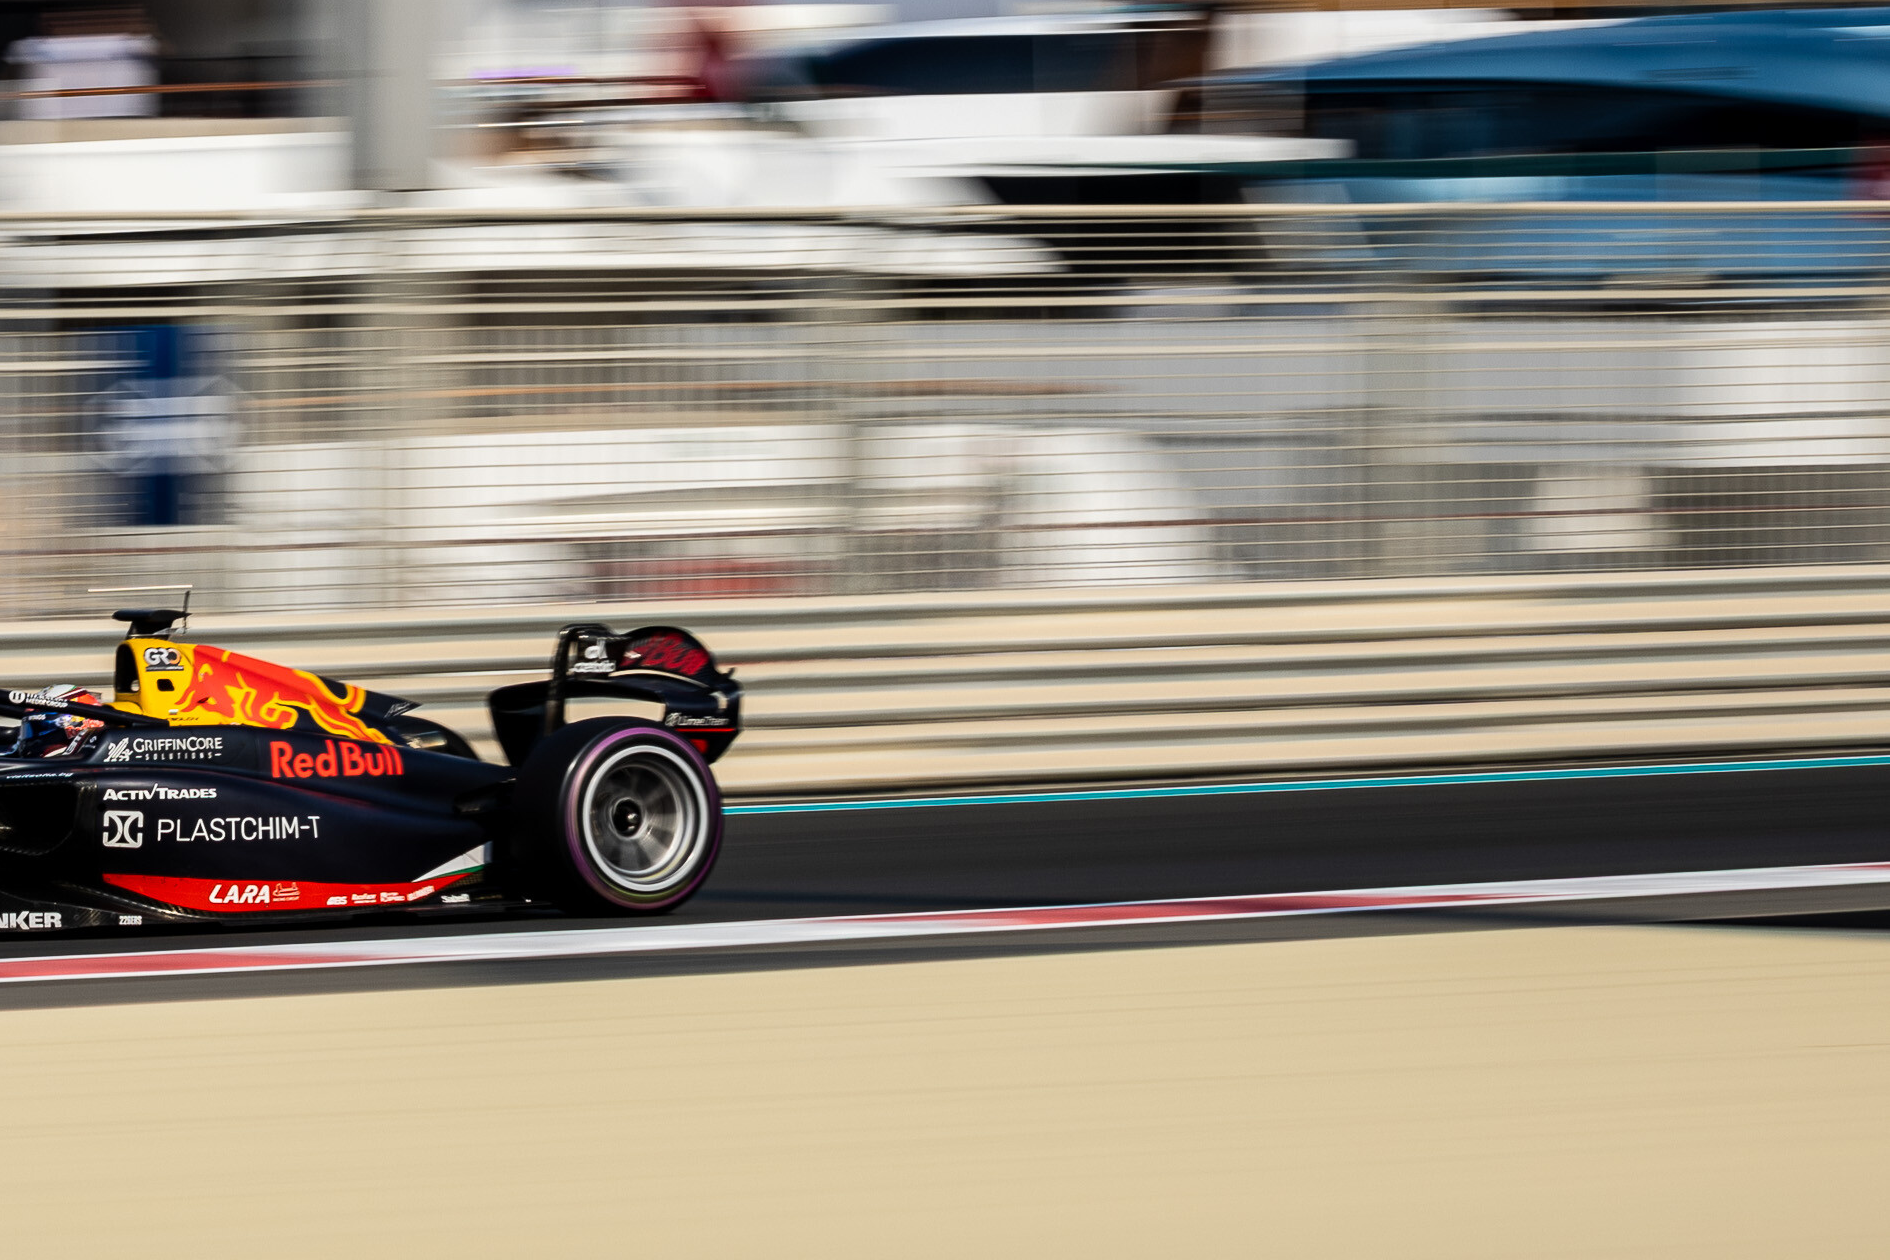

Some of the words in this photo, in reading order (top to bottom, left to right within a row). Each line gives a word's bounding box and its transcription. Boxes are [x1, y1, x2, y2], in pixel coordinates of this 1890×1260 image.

[270, 740, 338, 778] Red
[341, 742, 405, 776] Bull
[157, 816, 320, 842] PLASTCHIM-T
[209, 884, 270, 904] LARA
